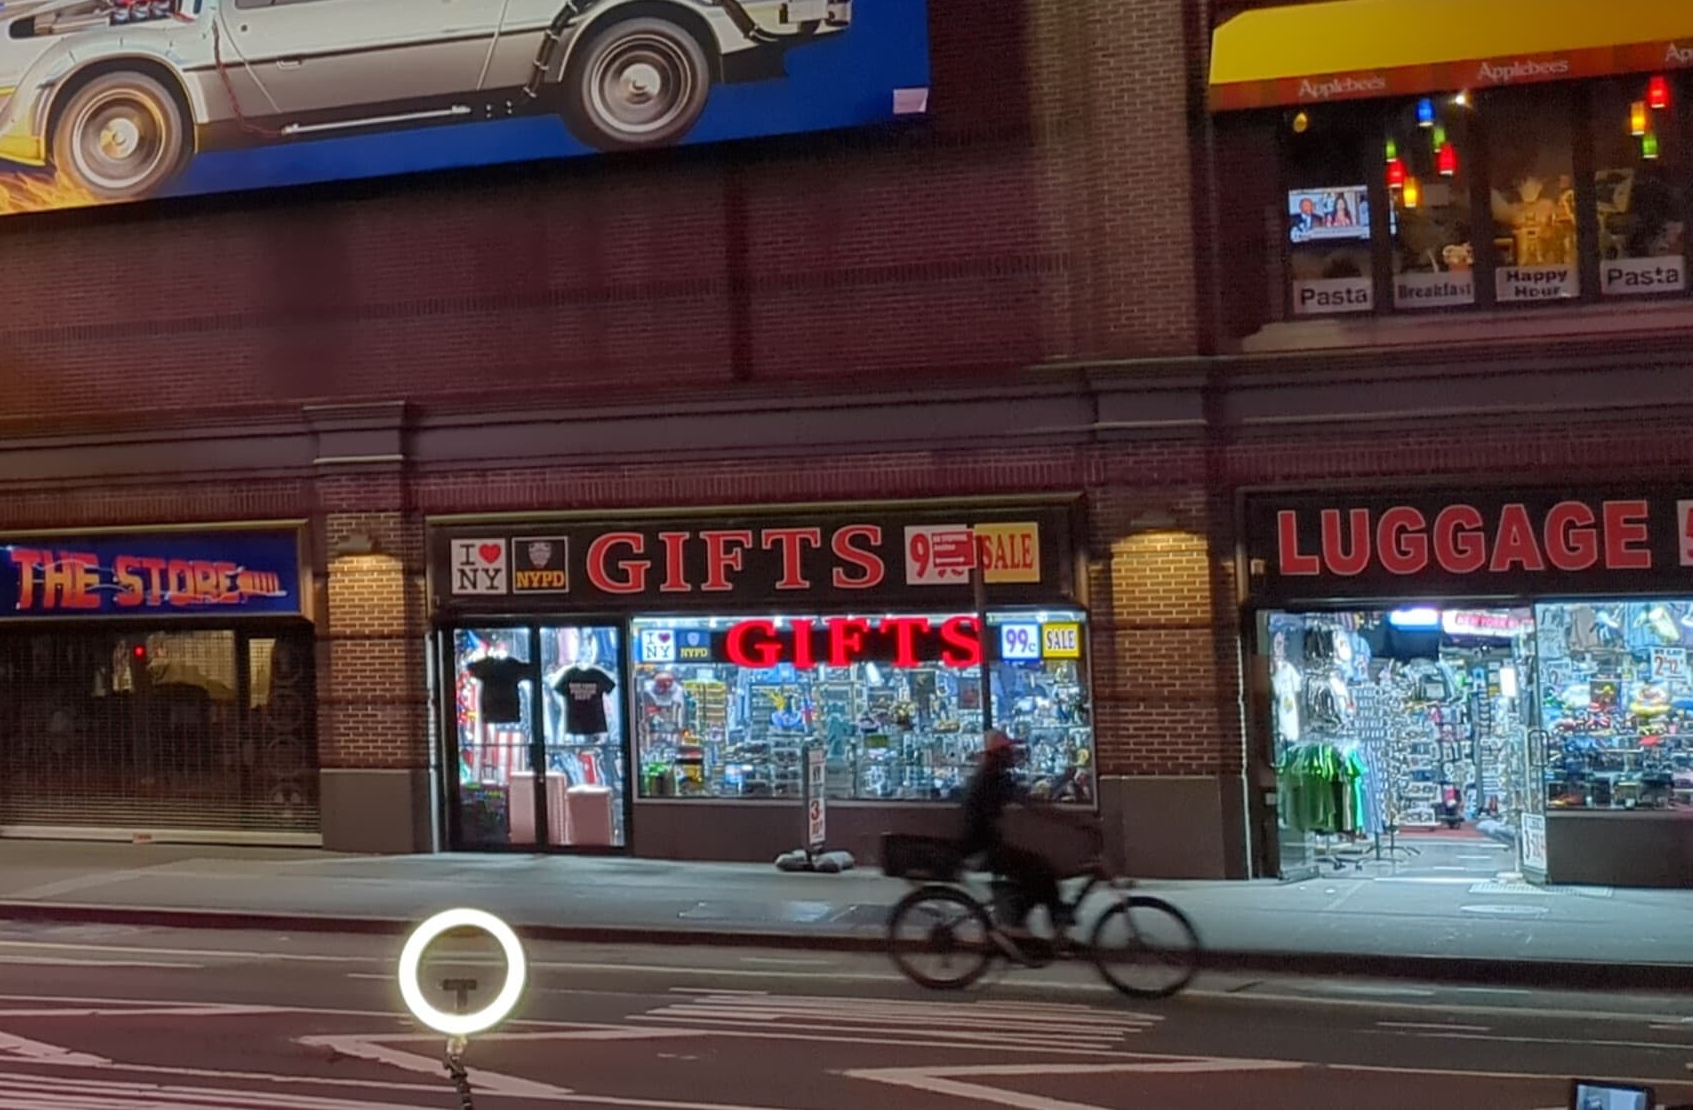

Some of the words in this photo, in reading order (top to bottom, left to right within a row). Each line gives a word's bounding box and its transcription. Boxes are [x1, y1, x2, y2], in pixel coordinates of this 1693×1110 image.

[1506, 267, 1568, 287] Happy
[1607, 265, 1679, 286] Pasta
[1300, 286, 1368, 307] Pasta
[1277, 500, 1652, 576] LUGGAGE
[459, 544, 476, 566] I
[586, 524, 885, 593] GIFTS
[980, 533, 1034, 571] SALE
[11, 548, 101, 610] THE
[113, 554, 240, 608] STORE
[457, 568, 502, 590] NY
[515, 571, 565, 588] NYPD
[725, 616, 986, 670] GIFTS
[1046, 630, 1075, 650] SALE
[646, 646, 671, 658] NY
